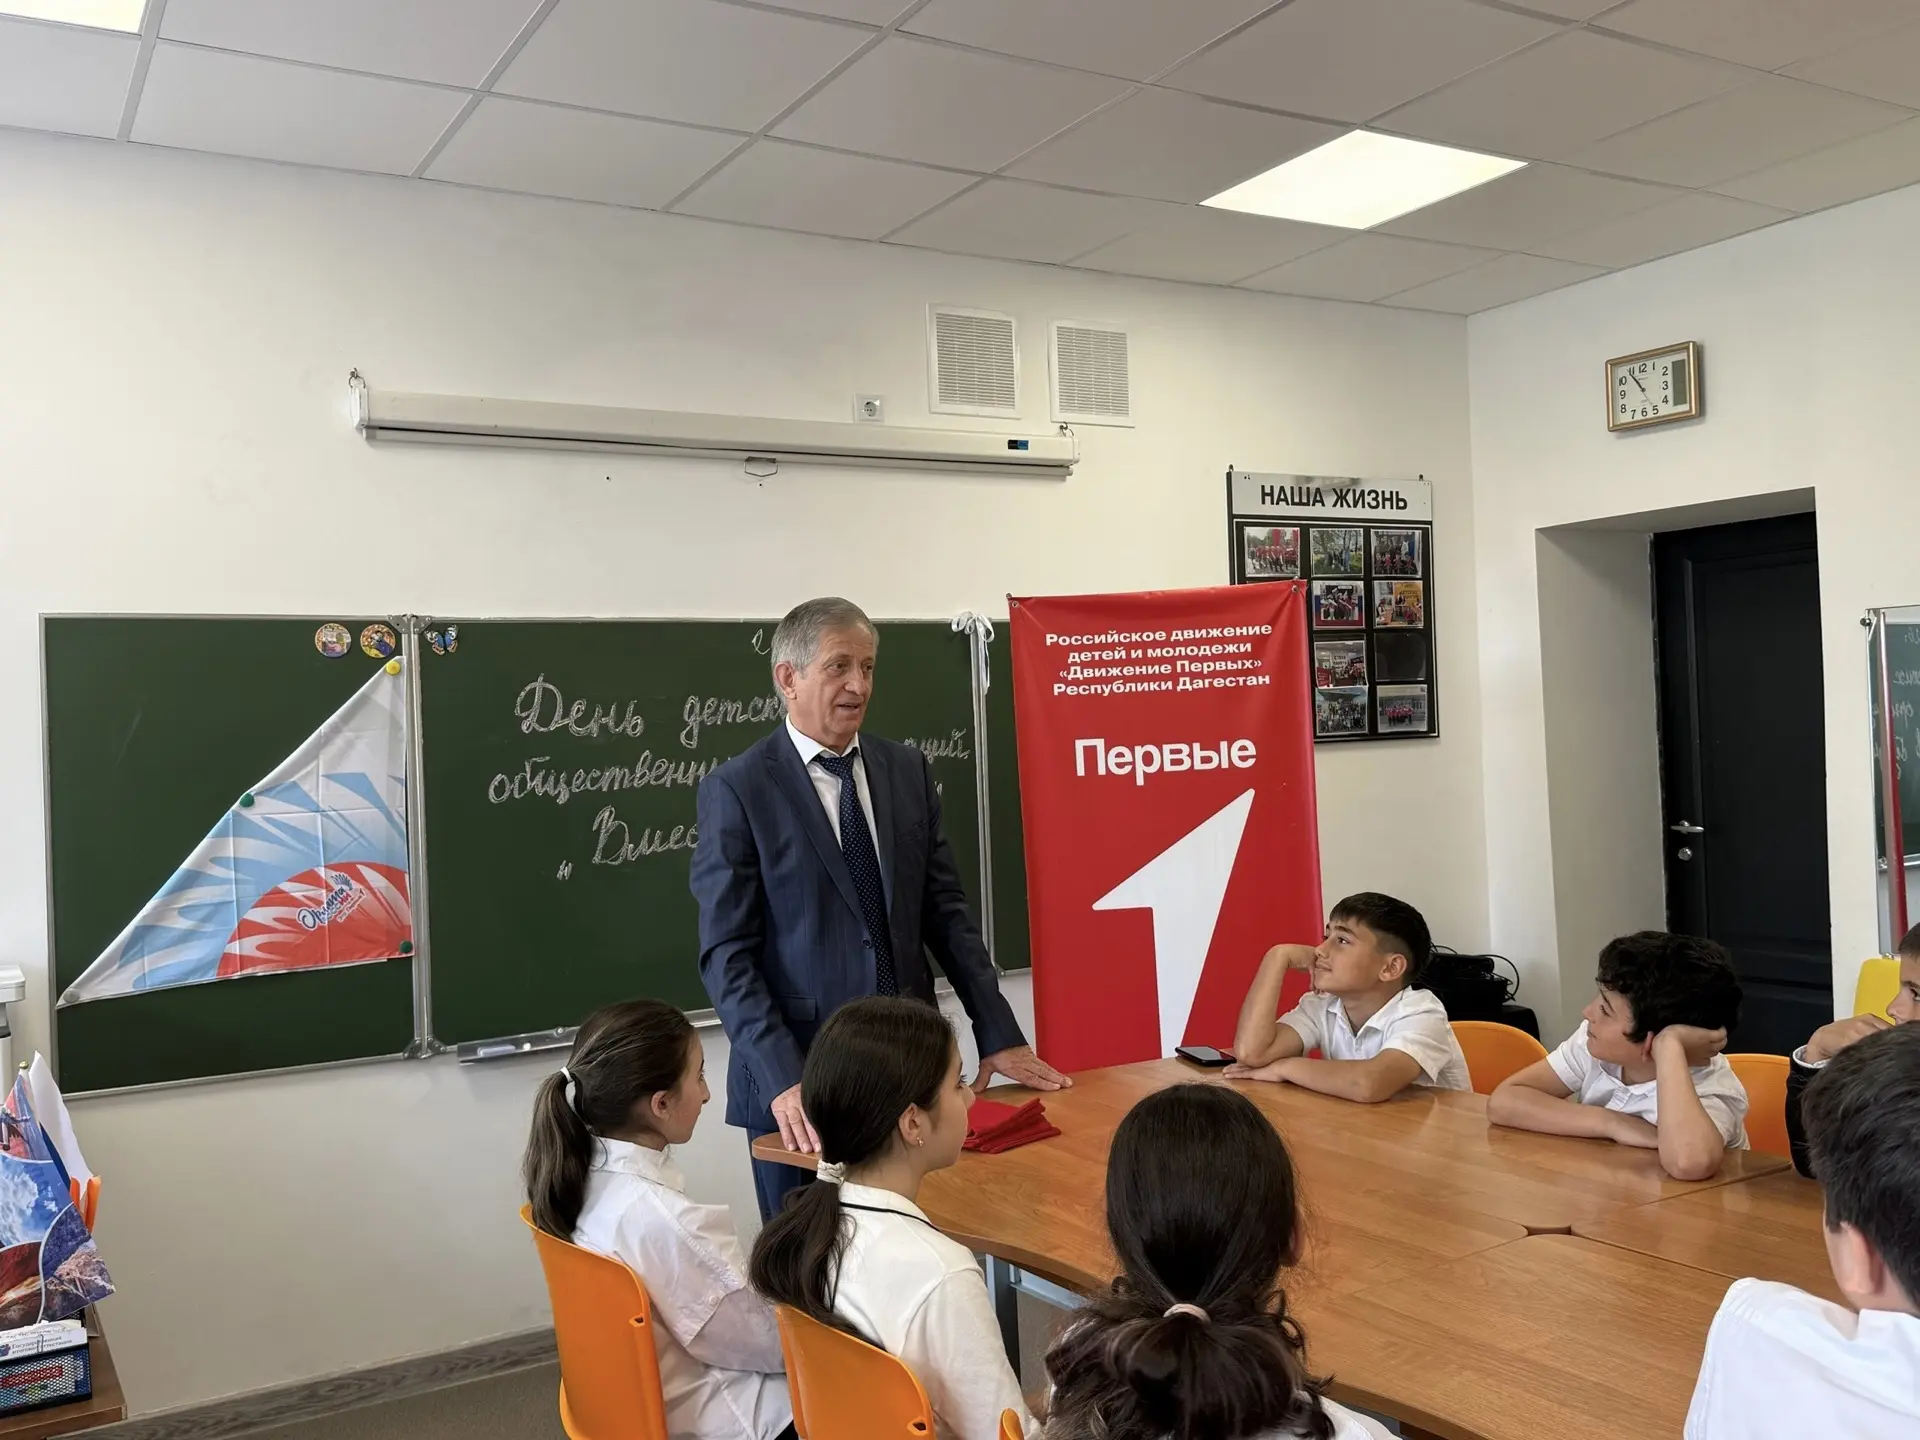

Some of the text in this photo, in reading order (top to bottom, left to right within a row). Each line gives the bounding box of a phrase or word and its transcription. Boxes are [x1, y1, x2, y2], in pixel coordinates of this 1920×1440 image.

[1638, 363, 1647, 374] 12
[1662, 366, 1669, 376] 2
[1619, 376, 1627, 386] 10
[1662, 380, 1669, 390] 3
[1619, 390, 1626, 399] 9
[1662, 395, 1669, 404] 4
[1620, 404, 1627, 413] 8
[1631, 405, 1659, 419] 7 6 5
[1260, 485, 1408, 511] НАША ЖИЗНЬ
[1045, 624, 1273, 646] Российское движение
[1067, 642, 1252, 664] детей и молодежи
[1059, 659, 1262, 681] «Движение Первых»
[1053, 674, 1270, 697] Республики Дагестан
[514, 672, 786, 749] День детск
[1074, 738, 1257, 786] Первые
[488, 749, 718, 805] общественн
